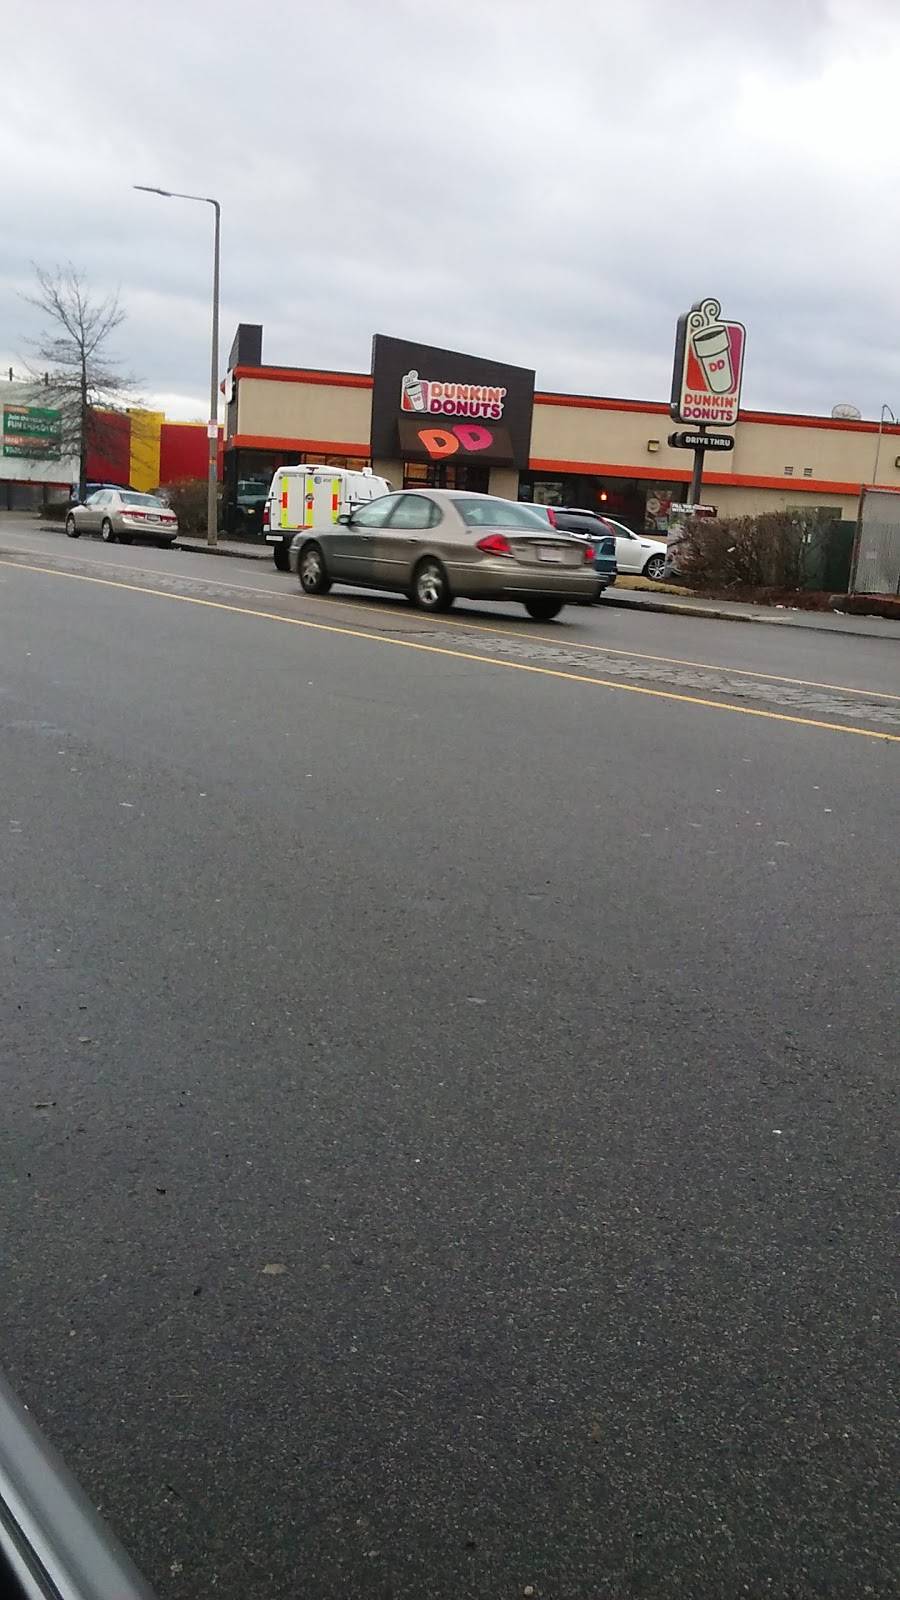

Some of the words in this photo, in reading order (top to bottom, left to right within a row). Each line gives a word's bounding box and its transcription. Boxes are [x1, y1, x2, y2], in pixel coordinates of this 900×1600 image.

[709, 359, 725, 372] DD
[431, 383, 505, 402] DUNKIN'
[684, 394, 737, 408] DUNKIN'
[430, 399, 501, 418] DONUTS
[683, 407, 733, 420] DONUTS
[685, 436, 709, 445] DRIVE
[709, 438, 731, 447] THRU
